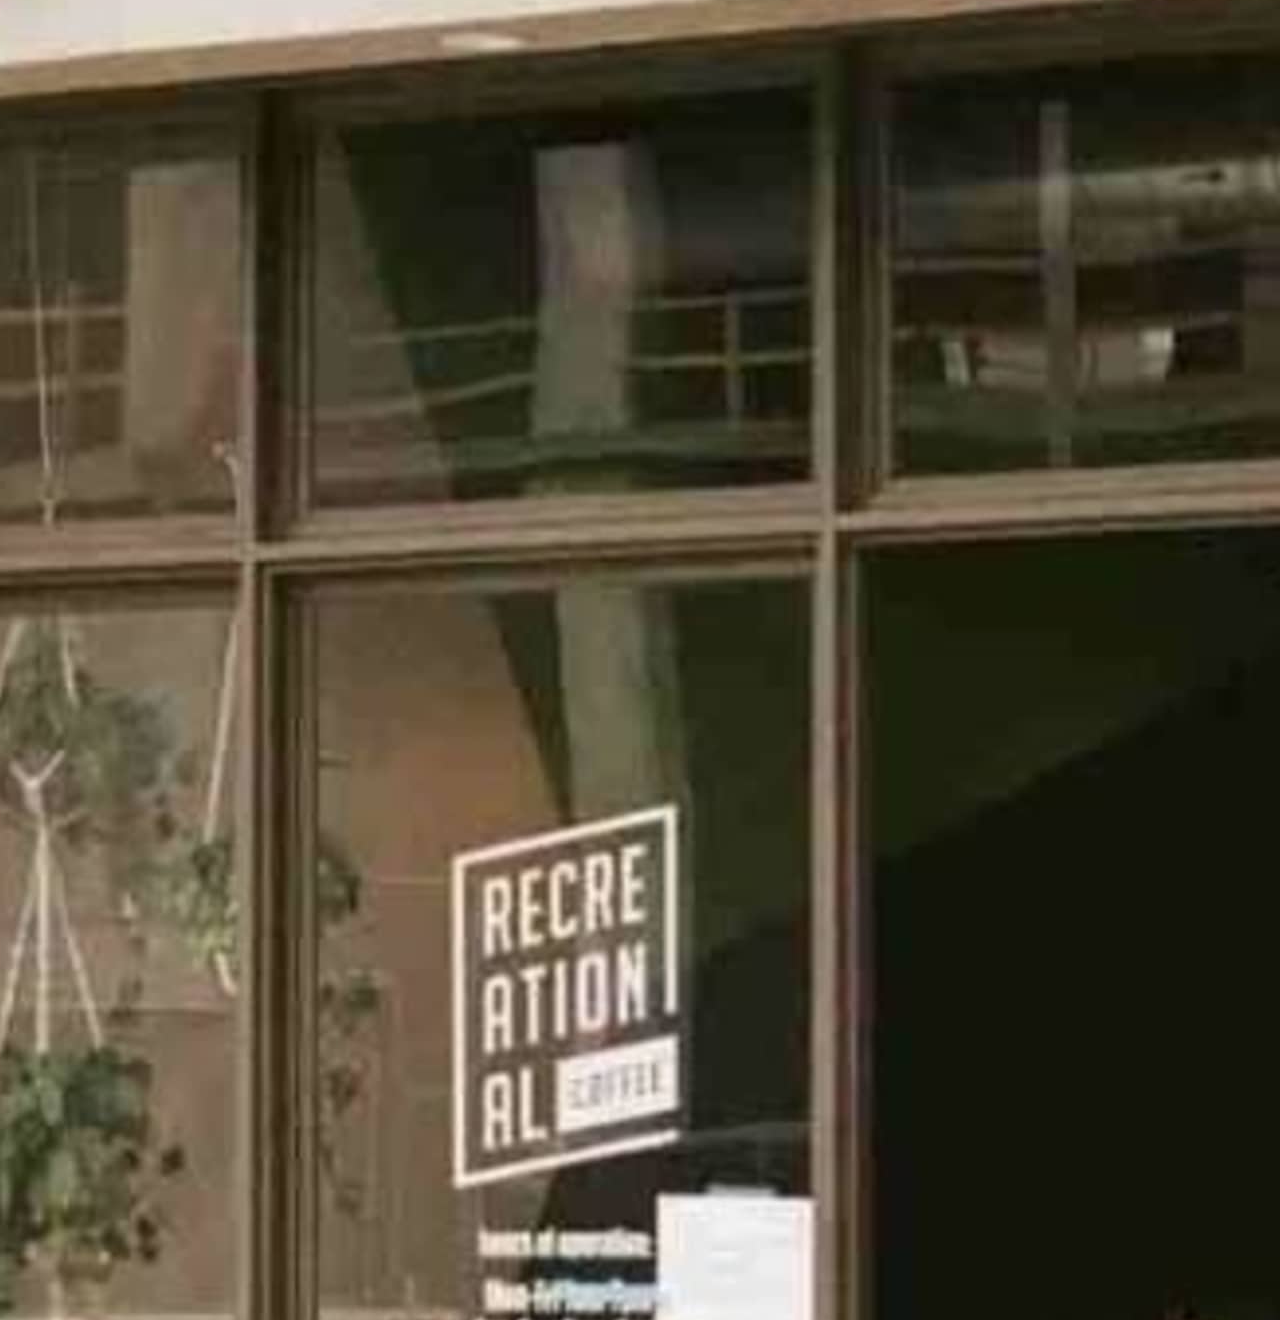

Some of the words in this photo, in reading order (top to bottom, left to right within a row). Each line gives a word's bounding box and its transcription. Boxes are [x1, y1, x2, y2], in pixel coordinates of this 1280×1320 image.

[483, 842, 648, 959] RECRE
[483, 940, 648, 1055] ATION
[482, 1065, 547, 1151] AL
